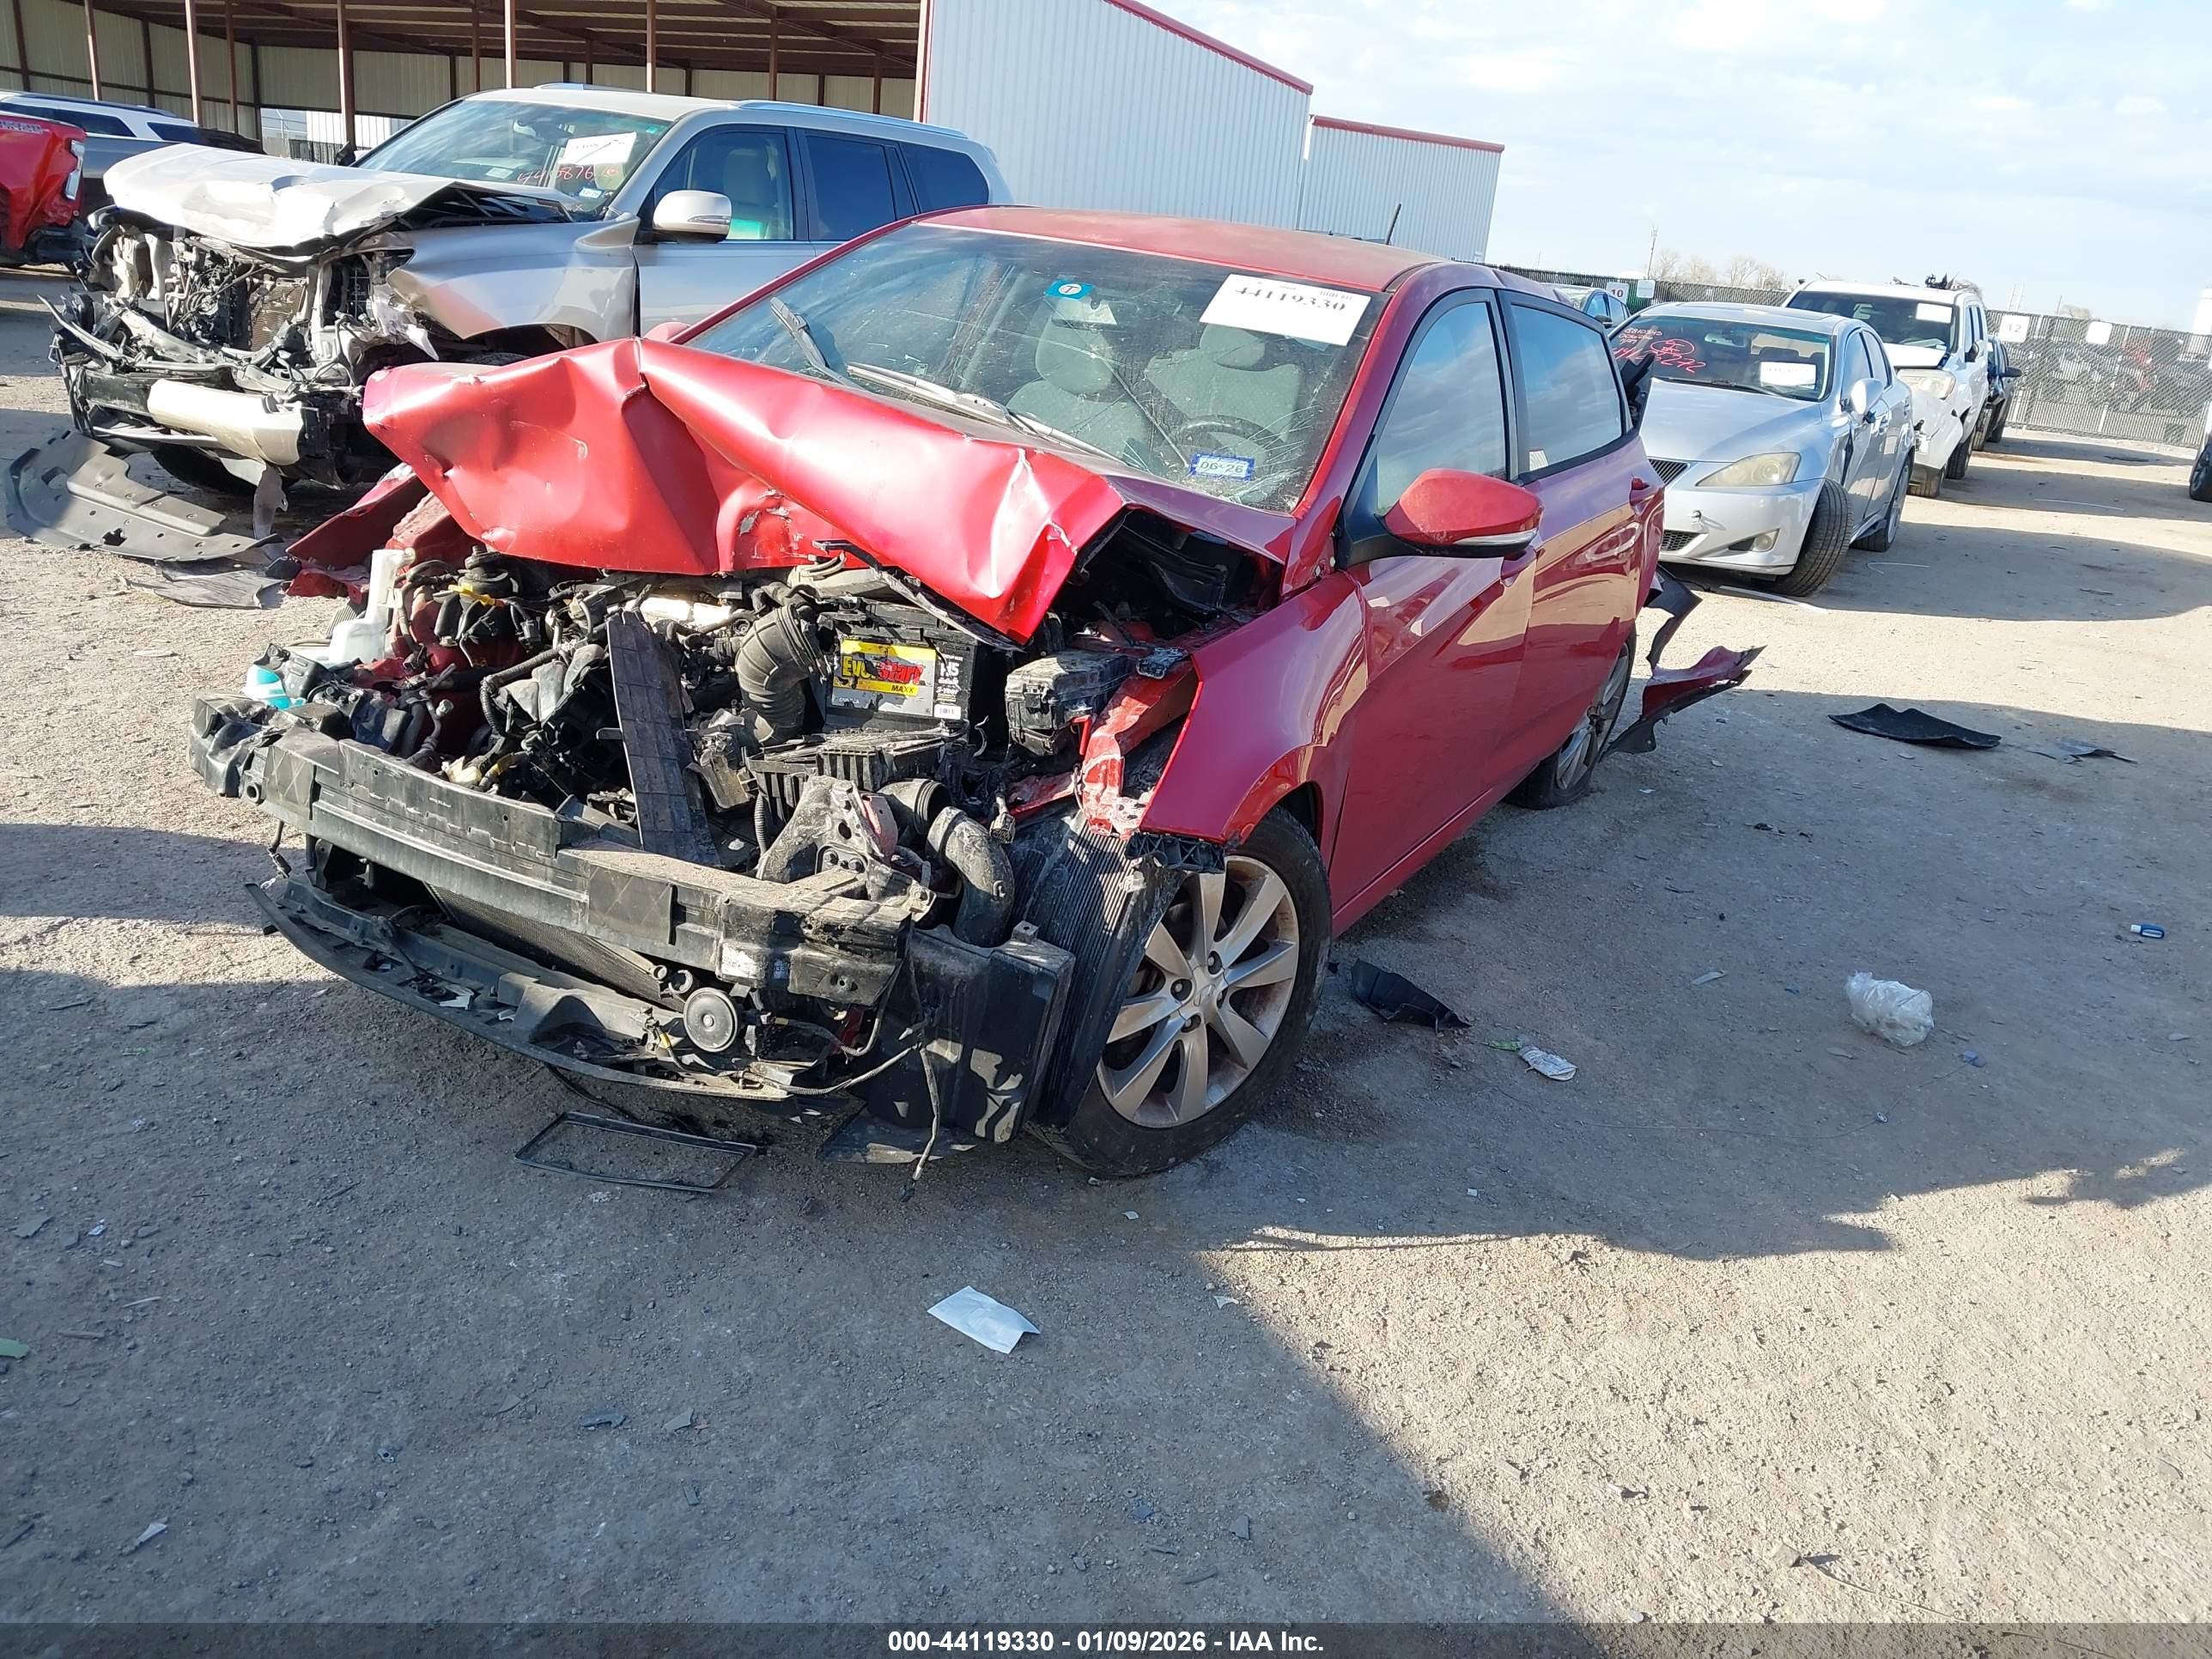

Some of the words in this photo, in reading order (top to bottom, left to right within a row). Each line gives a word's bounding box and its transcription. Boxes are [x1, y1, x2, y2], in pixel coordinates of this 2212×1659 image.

[1611, 289, 1624, 298] 10
[1236, 287, 1346, 311] 44119330
[2008, 324, 2022, 333] 12
[842, 655, 925, 685] EvStart
[890, 684, 915, 694] MAXX
